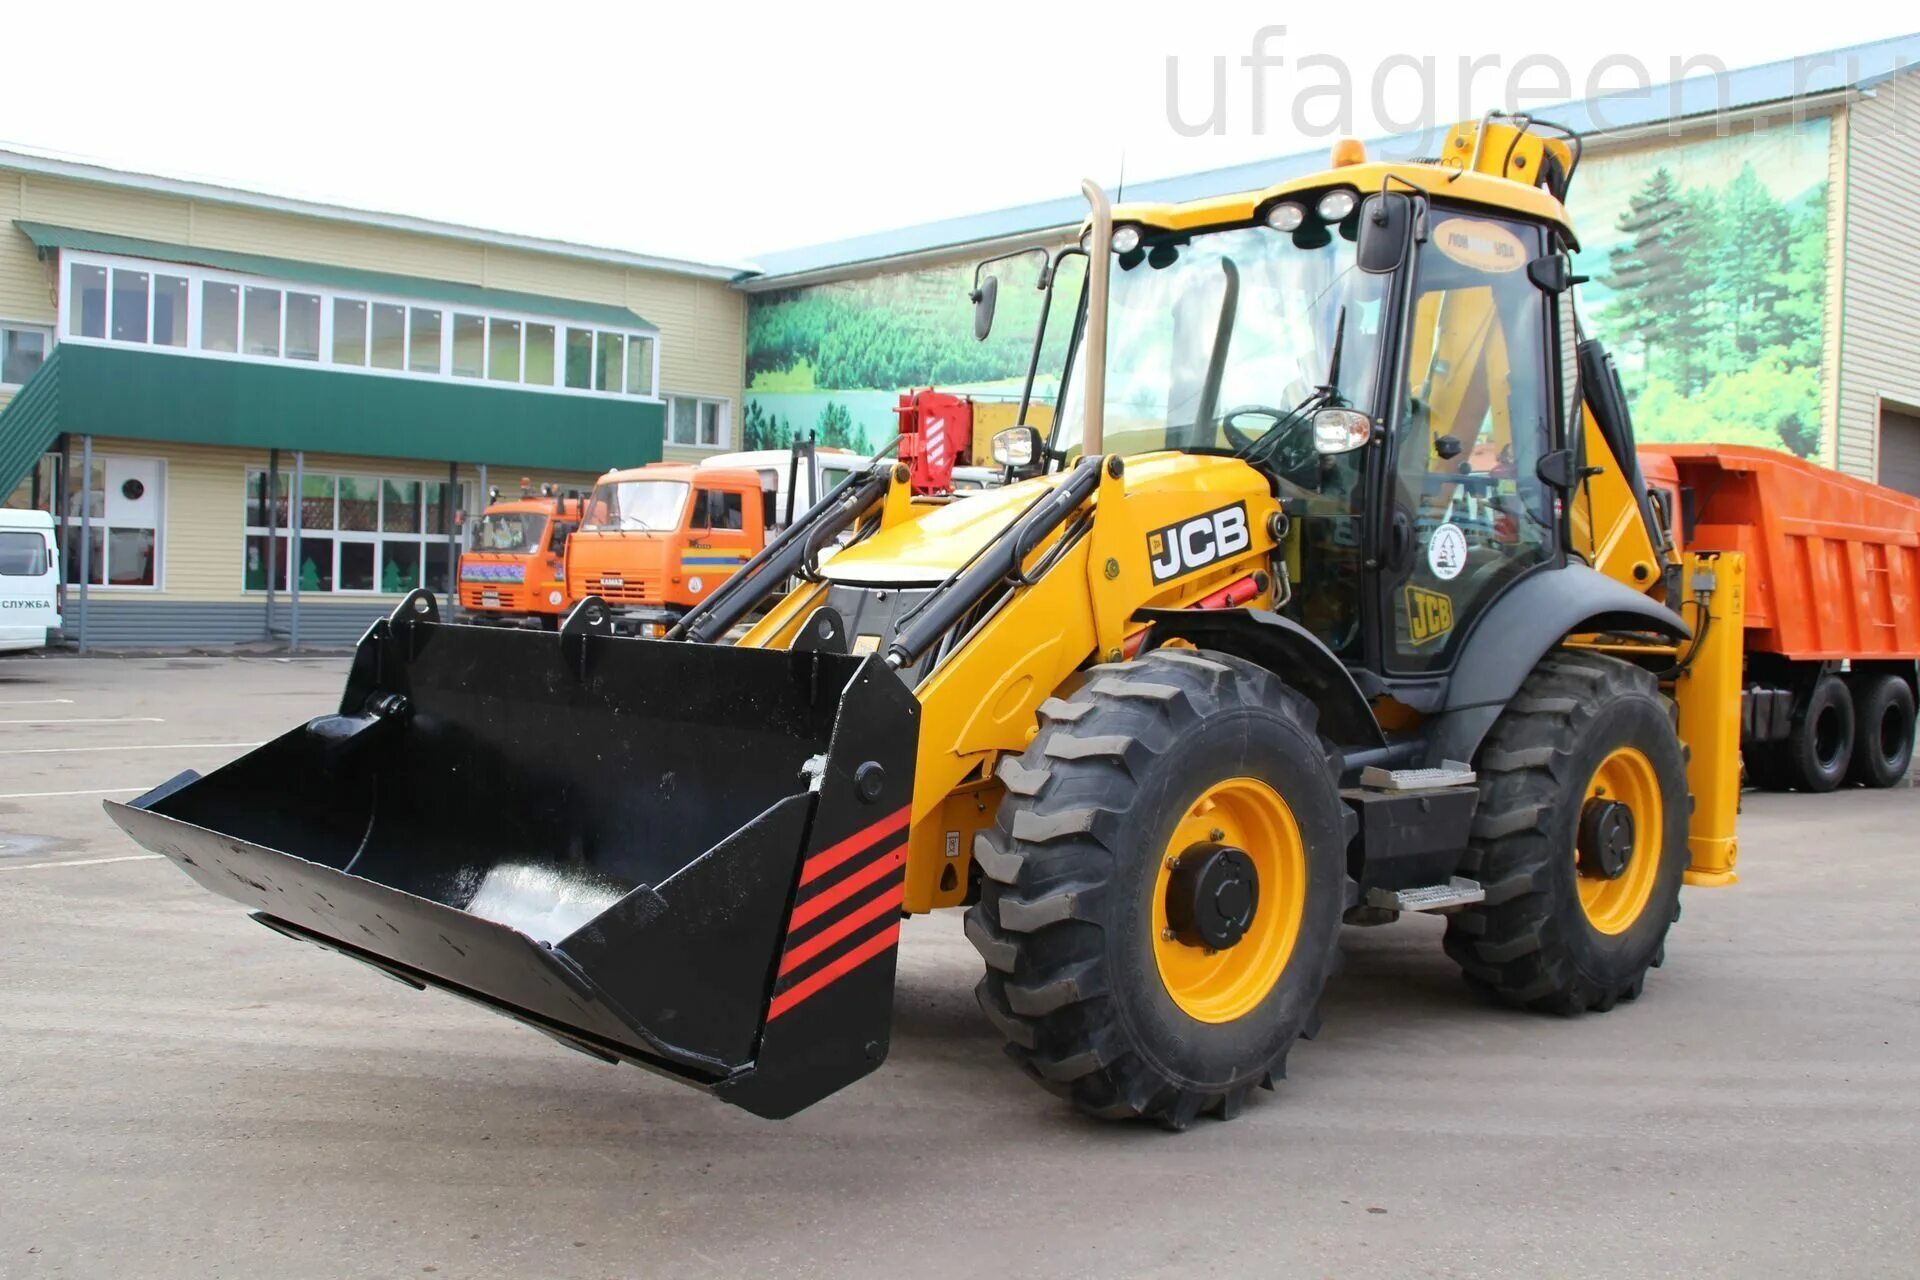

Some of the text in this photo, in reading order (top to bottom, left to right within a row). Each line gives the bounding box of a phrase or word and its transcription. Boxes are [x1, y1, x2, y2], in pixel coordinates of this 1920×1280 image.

[1152, 506, 1249, 579] JCB
[2, 600, 51, 609] СЛУЖБА
[1412, 592, 1451, 638] JCB
